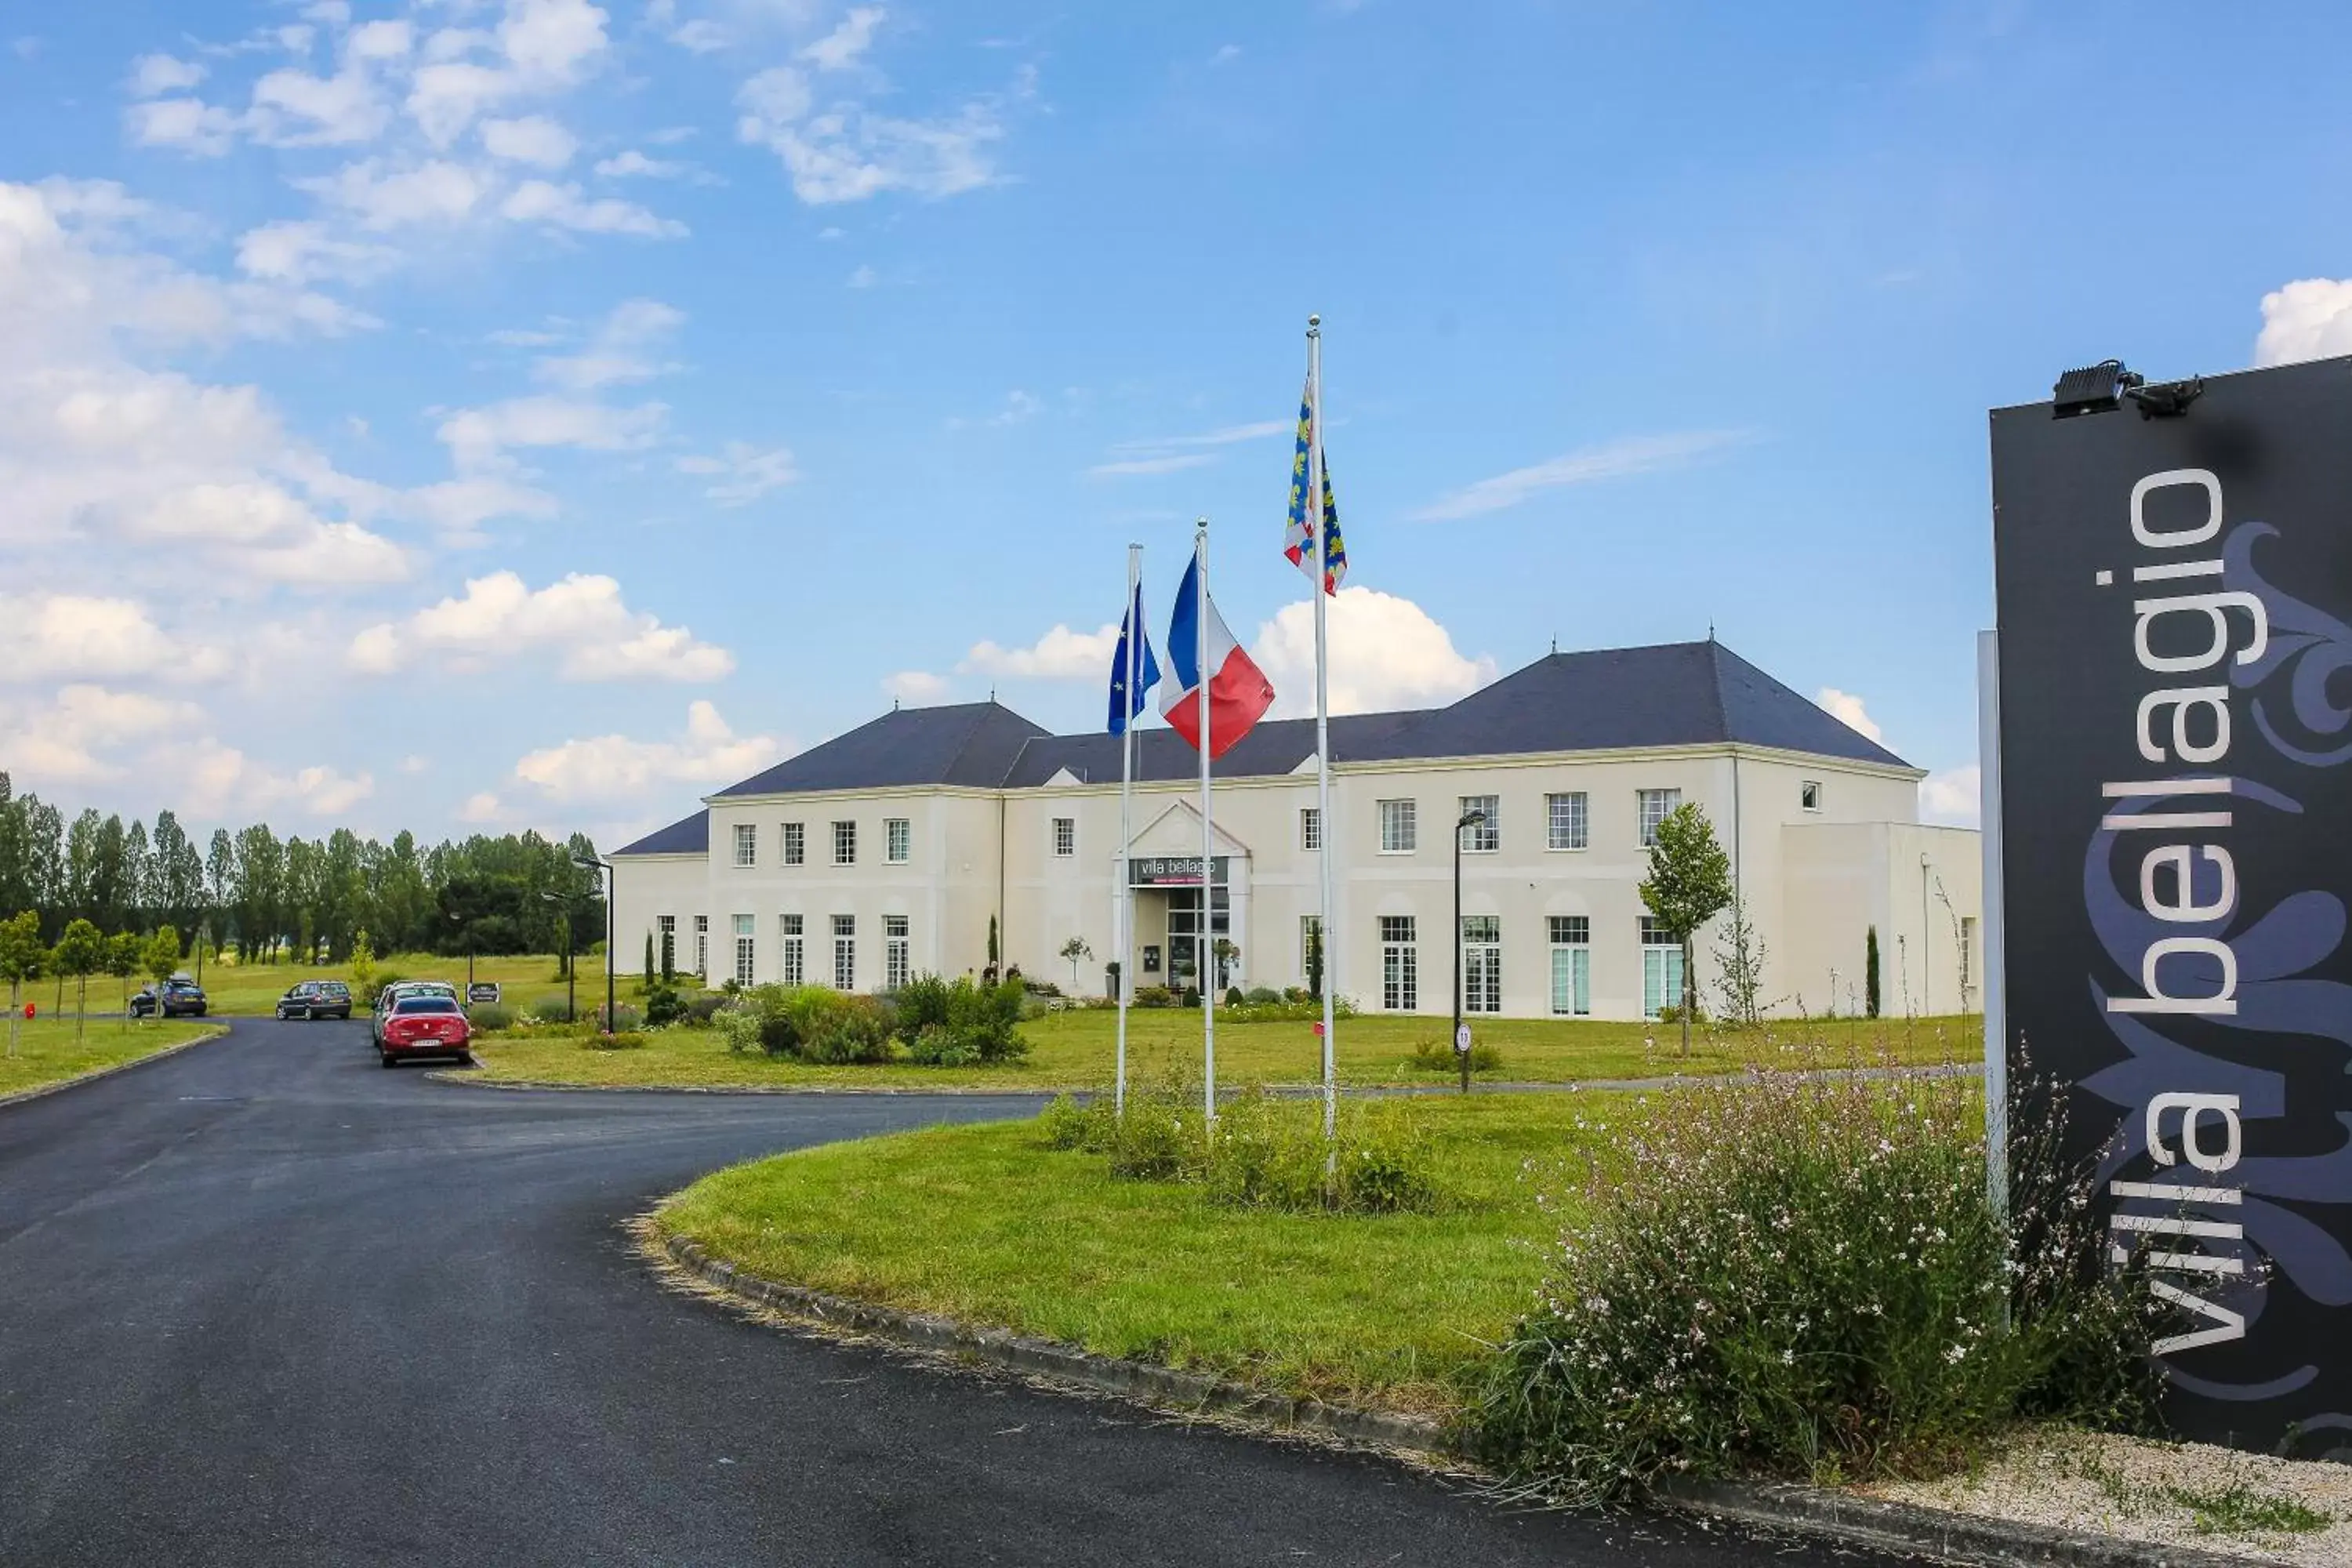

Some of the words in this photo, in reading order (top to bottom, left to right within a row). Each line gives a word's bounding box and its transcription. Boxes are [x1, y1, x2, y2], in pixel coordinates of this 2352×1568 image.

[1169, 858, 1216, 877] bellago
[2096, 468, 2268, 1015] bellagio
[2109, 1092, 2245, 1355] villa
